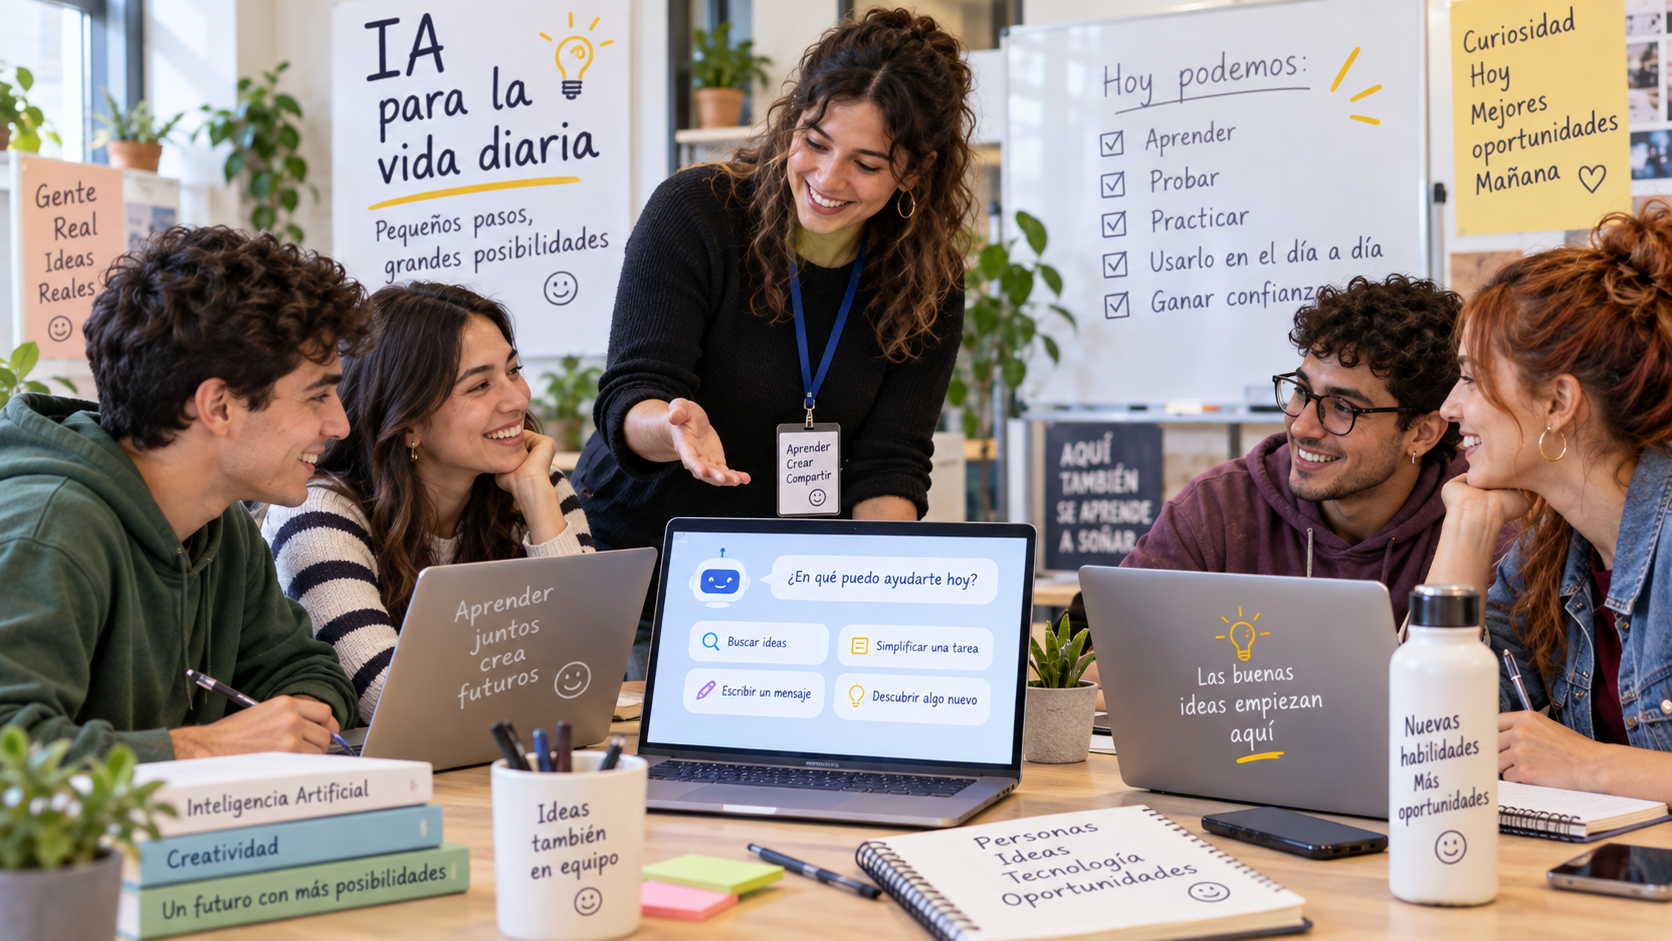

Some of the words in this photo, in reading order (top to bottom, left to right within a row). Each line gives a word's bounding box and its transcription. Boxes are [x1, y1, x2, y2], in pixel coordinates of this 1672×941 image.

[1463, 6, 1576, 53] Curiosidad
[364, 12, 444, 82] IA
[1103, 63, 1153, 107] Hoy
[1180, 51, 1308, 104] podemos:
[1470, 61, 1510, 92] Hoy
[379, 89, 468, 144] para
[493, 65, 533, 111] la
[1471, 95, 1548, 130] Mejores
[378, 134, 461, 184] vida
[478, 121, 600, 171] diaria
[1145, 120, 1236, 157] Aprender
[1472, 109, 1619, 167] oportunidades
[35, 180, 97, 209] Gente
[1150, 166, 1220, 193] Probar
[1476, 165, 1561, 196] Mañana
[54, 211, 98, 241] Real
[375, 214, 462, 247] Pequeños
[474, 208, 533, 239] pasos,
[1151, 207, 1250, 233] Practicar
[45, 248, 94, 273] Ideas
[384, 246, 462, 284] grandes
[474, 226, 609, 274] posibilidades
[1150, 246, 1215, 272] Usarlo
[1225, 251, 1248, 268] en
[1259, 241, 1276, 265] el
[1287, 239, 1319, 263] día
[1328, 245, 1341, 261] a
[1351, 235, 1384, 259] día
[39, 277, 95, 304] Reales
[1151, 290, 1215, 313] Ganar
[786, 441, 831, 457] Aprender
[787, 459, 814, 469] Crear
[1060, 432, 1113, 467] AQUÍ
[786, 470, 832, 486] Compartir
[1060, 463, 1139, 495] TAMBIÉN
[1056, 500, 1076, 525] SE
[1079, 499, 1153, 525] APRENDE
[1058, 529, 1074, 554] A
[1077, 525, 1137, 554] SOÑAR
[787, 570, 810, 585] ¿En
[815, 570, 837, 588] qué
[841, 571, 880, 588] puedo
[884, 572, 942, 590] ayudarte
[947, 572, 978, 590] hoy?
[454, 585, 554, 626] Aprender
[470, 619, 540, 656] juntos
[727, 636, 760, 648] Buscar
[762, 636, 787, 649] ideas
[876, 640, 928, 655] Simplificar
[931, 643, 949, 653] una
[952, 642, 979, 654] tarea
[480, 648, 526, 672] crea
[457, 668, 539, 709] futuros
[1197, 667, 1226, 687] Las
[1233, 664, 1294, 684] buenas
[721, 685, 756, 698] Escribir
[759, 689, 771, 698] un
[773, 688, 812, 702] mensaje
[872, 691, 919, 703] Descubrir
[923, 691, 945, 707] algo
[947, 696, 978, 706] nuevo
[1180, 694, 1226, 716] ideas
[1234, 692, 1323, 718] empiezan
[1231, 720, 1274, 751] aquí
[1404, 713, 1460, 738] Nuevas
[1400, 736, 1479, 767] habilidades
[1413, 771, 1440, 792] Más
[187, 791, 289, 819] Inteligencia
[295, 779, 369, 804] Artificial
[537, 801, 589, 824] Ideas
[1398, 788, 1490, 827] oportunidades
[531, 825, 606, 852] también
[973, 822, 1099, 849] Personas
[167, 836, 279, 869] Creatividad
[531, 865, 552, 879] en
[560, 851, 619, 880] equipo
[994, 845, 1071, 866] Ideas
[1001, 852, 1145, 885] Tecnología
[162, 900, 187, 920] Un
[193, 894, 252, 919] futuro
[258, 888, 289, 906] con
[295, 880, 329, 900] más
[336, 864, 447, 901] posibilidades
[1001, 861, 1198, 908] Oportunidades
